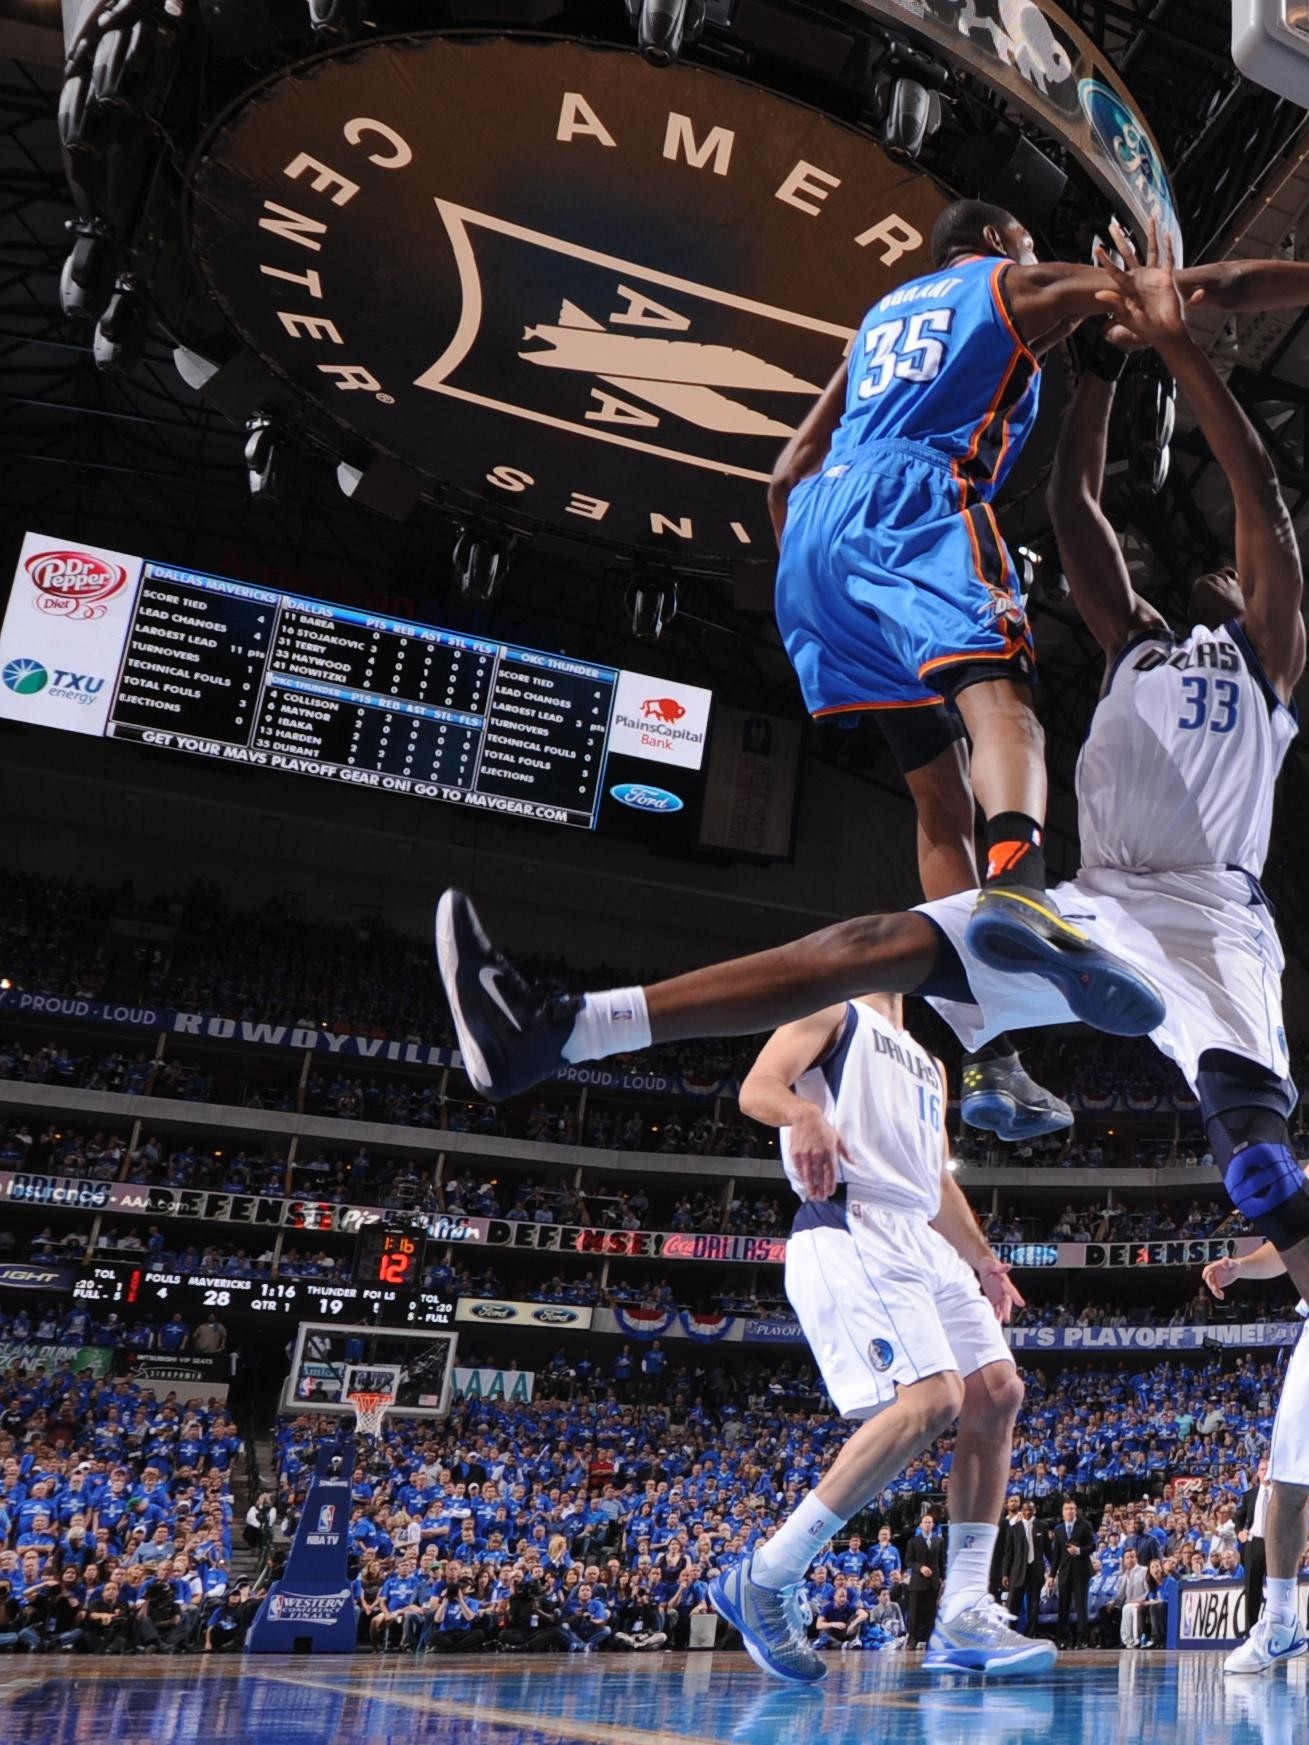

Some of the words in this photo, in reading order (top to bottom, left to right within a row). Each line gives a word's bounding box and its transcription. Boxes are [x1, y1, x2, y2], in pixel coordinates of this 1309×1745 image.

[556, 91, 924, 267] AMER
[858, 307, 956, 401] 35
[41, 561, 111, 592] Pepper
[66, 558, 91, 575] Dr
[153, 566, 198, 585] DALLAS
[205, 578, 277, 603] MAVERICKS
[44, 598, 70, 609] Diet
[143, 589, 179, 604] SCORE
[183, 597, 207, 609] TIED
[138, 606, 169, 619] LEAD
[171, 613, 226, 632] CHANGES
[286, 598, 333, 617] DALLAS
[366, 616, 387, 629] PTS
[393, 622, 415, 636] REB
[420, 630, 442, 642] AST
[447, 635, 466, 648] STL
[472, 641, 493, 653] FLS
[299, 615, 334, 629] BAREA
[134, 623, 185, 640] LARGEST
[187, 635, 217, 647] LEAD
[247, 649, 264, 658] pts
[295, 640, 326, 653] TERRY
[296, 628, 364, 650] STOJAKOVIC
[132, 640, 199, 662] TURNOVERS
[291, 652, 351, 671] HAYWOOD
[520, 652, 545, 665] OKC
[547, 658, 599, 678] THUNDER
[52, 669, 105, 694] TXU
[128, 658, 190, 678] TECHNICAL
[193, 671, 230, 686] FOULS
[289, 663, 346, 682] NOWITZKI
[498, 669, 529, 682] SCORE
[532, 677, 553, 687] TIED
[48, 686, 97, 705] energy
[123, 675, 159, 690] TOTAL
[163, 683, 200, 698] FOULS
[495, 685, 521, 697] LEAD
[523, 691, 571, 708] CHANGES
[118, 692, 180, 712] EJECTIONS
[283, 692, 338, 710] COLLISON
[1178, 676, 1240, 733] 33
[280, 704, 330, 721] MAYNOR
[492, 701, 536, 716] LARGEST
[537, 711, 563, 722] LEAD
[589, 724, 604, 732] pts
[278, 717, 312, 730] IBAKA
[490, 717, 548, 736] TURNOVERS
[615, 715, 703, 744] PlainsCapital
[275, 729, 321, 744] HARDEN
[487, 733, 541, 751] TECHNICAL
[543, 745, 576, 758] FOULS
[641, 734, 673, 750] Bank
[272, 741, 319, 757] DURANT
[484, 749, 515, 762] TOTAL
[518, 756, 550, 769] FOULS
[142, 730, 177, 745] GET
[177, 736, 220, 755] YOUR
[223, 746, 266, 763] MAVS
[271, 755, 337, 776] PLAYOFF
[339, 769, 379, 785] GEAR
[382, 777, 411, 791] ON!
[414, 783, 438, 796] GO
[441, 788, 461, 800] TO
[464, 793, 567, 822] MAVGEAR.COM
[480, 765, 533, 782] EJECTIONS
[624, 786, 668, 809] Ford
[20, 994, 89, 1016] PROUD
[102, 1005, 157, 1025] LOUD
[872, 1027, 939, 1090] DALLAS
[557, 1068, 613, 1086] PROUD
[622, 1075, 667, 1091] LOUD
[914, 1085, 940, 1132] 16
[94, 1269, 116, 1280] TOL
[145, 1273, 181, 1285] FOULS
[379, 1254, 410, 1284] 12
[73, 1289, 100, 1300] FULL
[156, 1287, 168, 1299] 4
[188, 1277, 252, 1290] MAVERICKS
[260, 1283, 296, 1299] 1:16
[307, 1285, 357, 1298] THUNDER
[203, 1290, 231, 1307] 28
[250, 1299, 277, 1311] QTR
[284, 1303, 290, 1312] 1
[319, 1299, 343, 1315] 19
[425, 1313, 449, 1324] FULL
[479, 1304, 510, 1319] Ford
[540, 1308, 570, 1323] Ford
[1006, 1326, 1056, 1346] IT'S
[1064, 1325, 1185, 1347] PLAYOFF
[1191, 1323, 1265, 1344] TIME!
[39, 1346, 82, 1360] DUNK
[306, 1535, 325, 1546] NBA
[326, 1535, 340, 1546] TV
[283, 1598, 346, 1608] WESTERN
[1192, 1590, 1230, 1638] NBA
